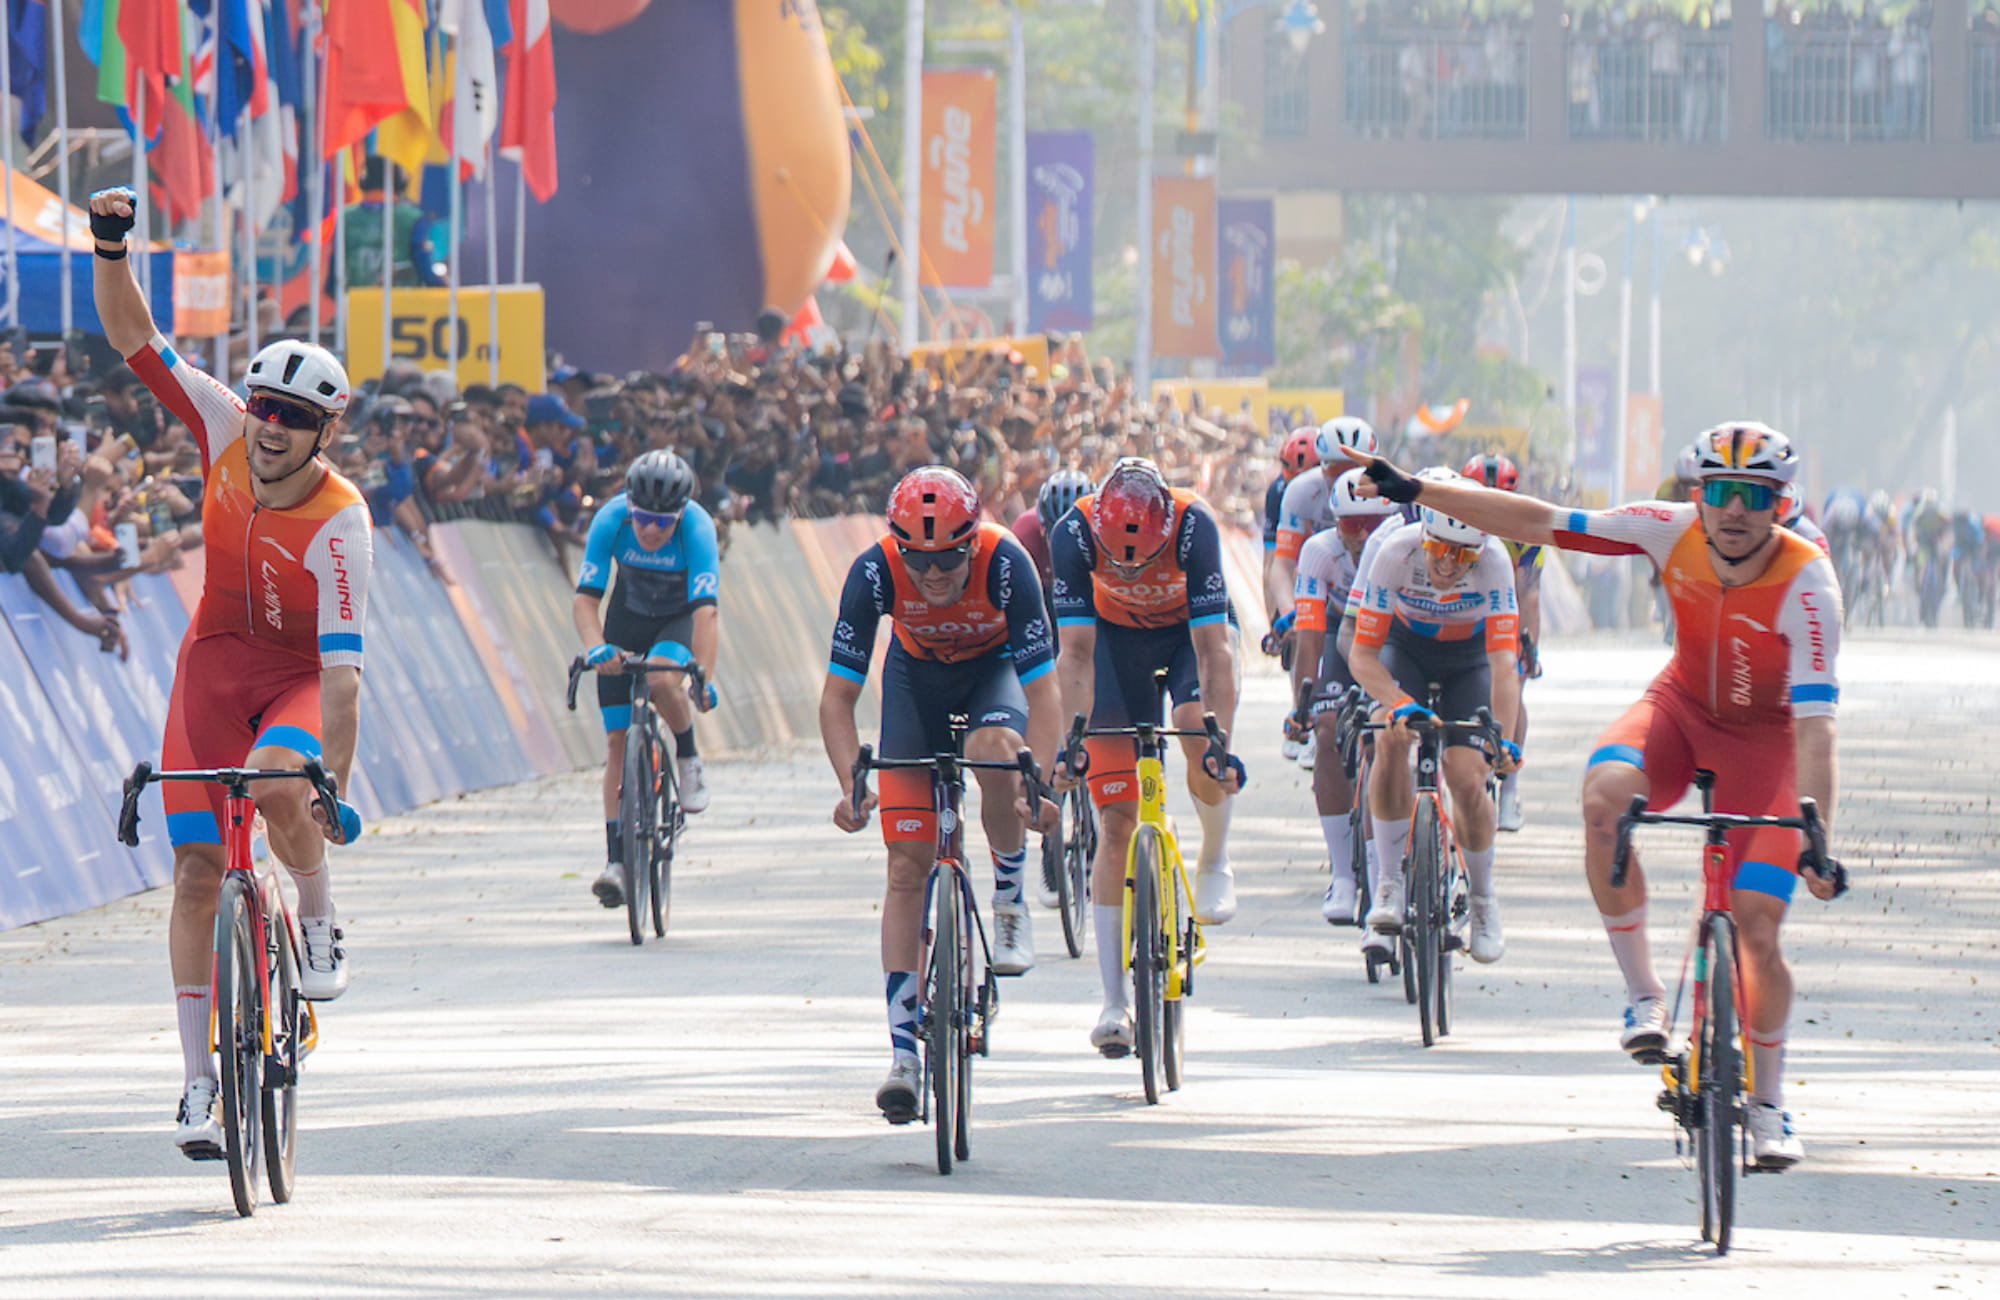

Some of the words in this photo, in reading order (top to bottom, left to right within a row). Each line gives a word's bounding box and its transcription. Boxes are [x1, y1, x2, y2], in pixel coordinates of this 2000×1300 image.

[392, 315, 470, 362] 50
[261, 560, 284, 632] LI-NING
[329, 537, 353, 622] LI-NING
[1053, 596, 1085, 604] NILLA
[833, 638, 867, 659] NILLA
[1014, 636, 1053, 660] VANILL
[1800, 591, 1827, 673] LI-NING
[1729, 636, 1752, 707] LI-NING
